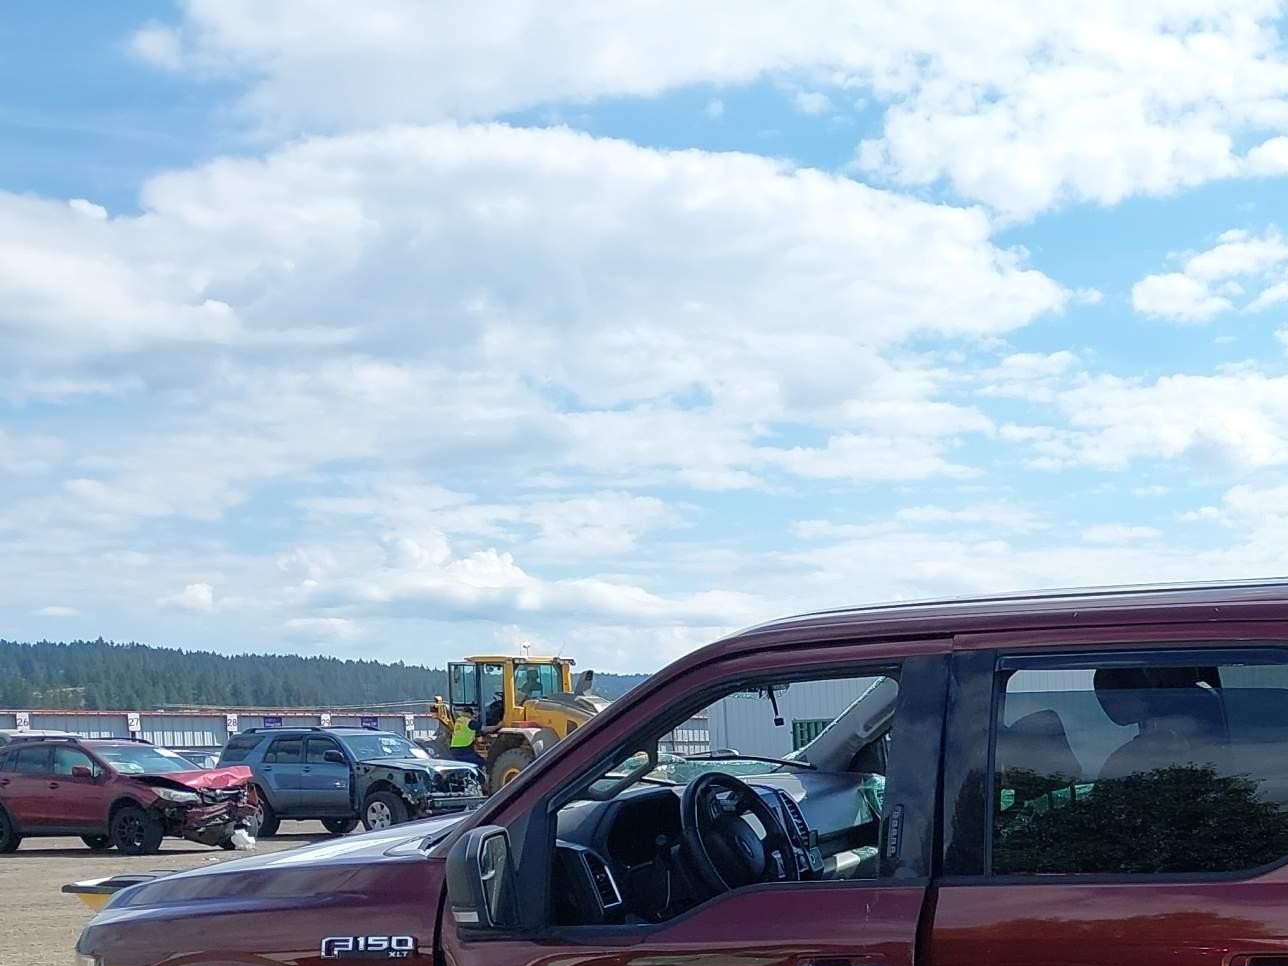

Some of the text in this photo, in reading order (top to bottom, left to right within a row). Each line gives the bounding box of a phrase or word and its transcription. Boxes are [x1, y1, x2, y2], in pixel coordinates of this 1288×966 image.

[16, 718, 29, 727] 26
[128, 718, 140, 727] 27
[227, 718, 238, 727] 28
